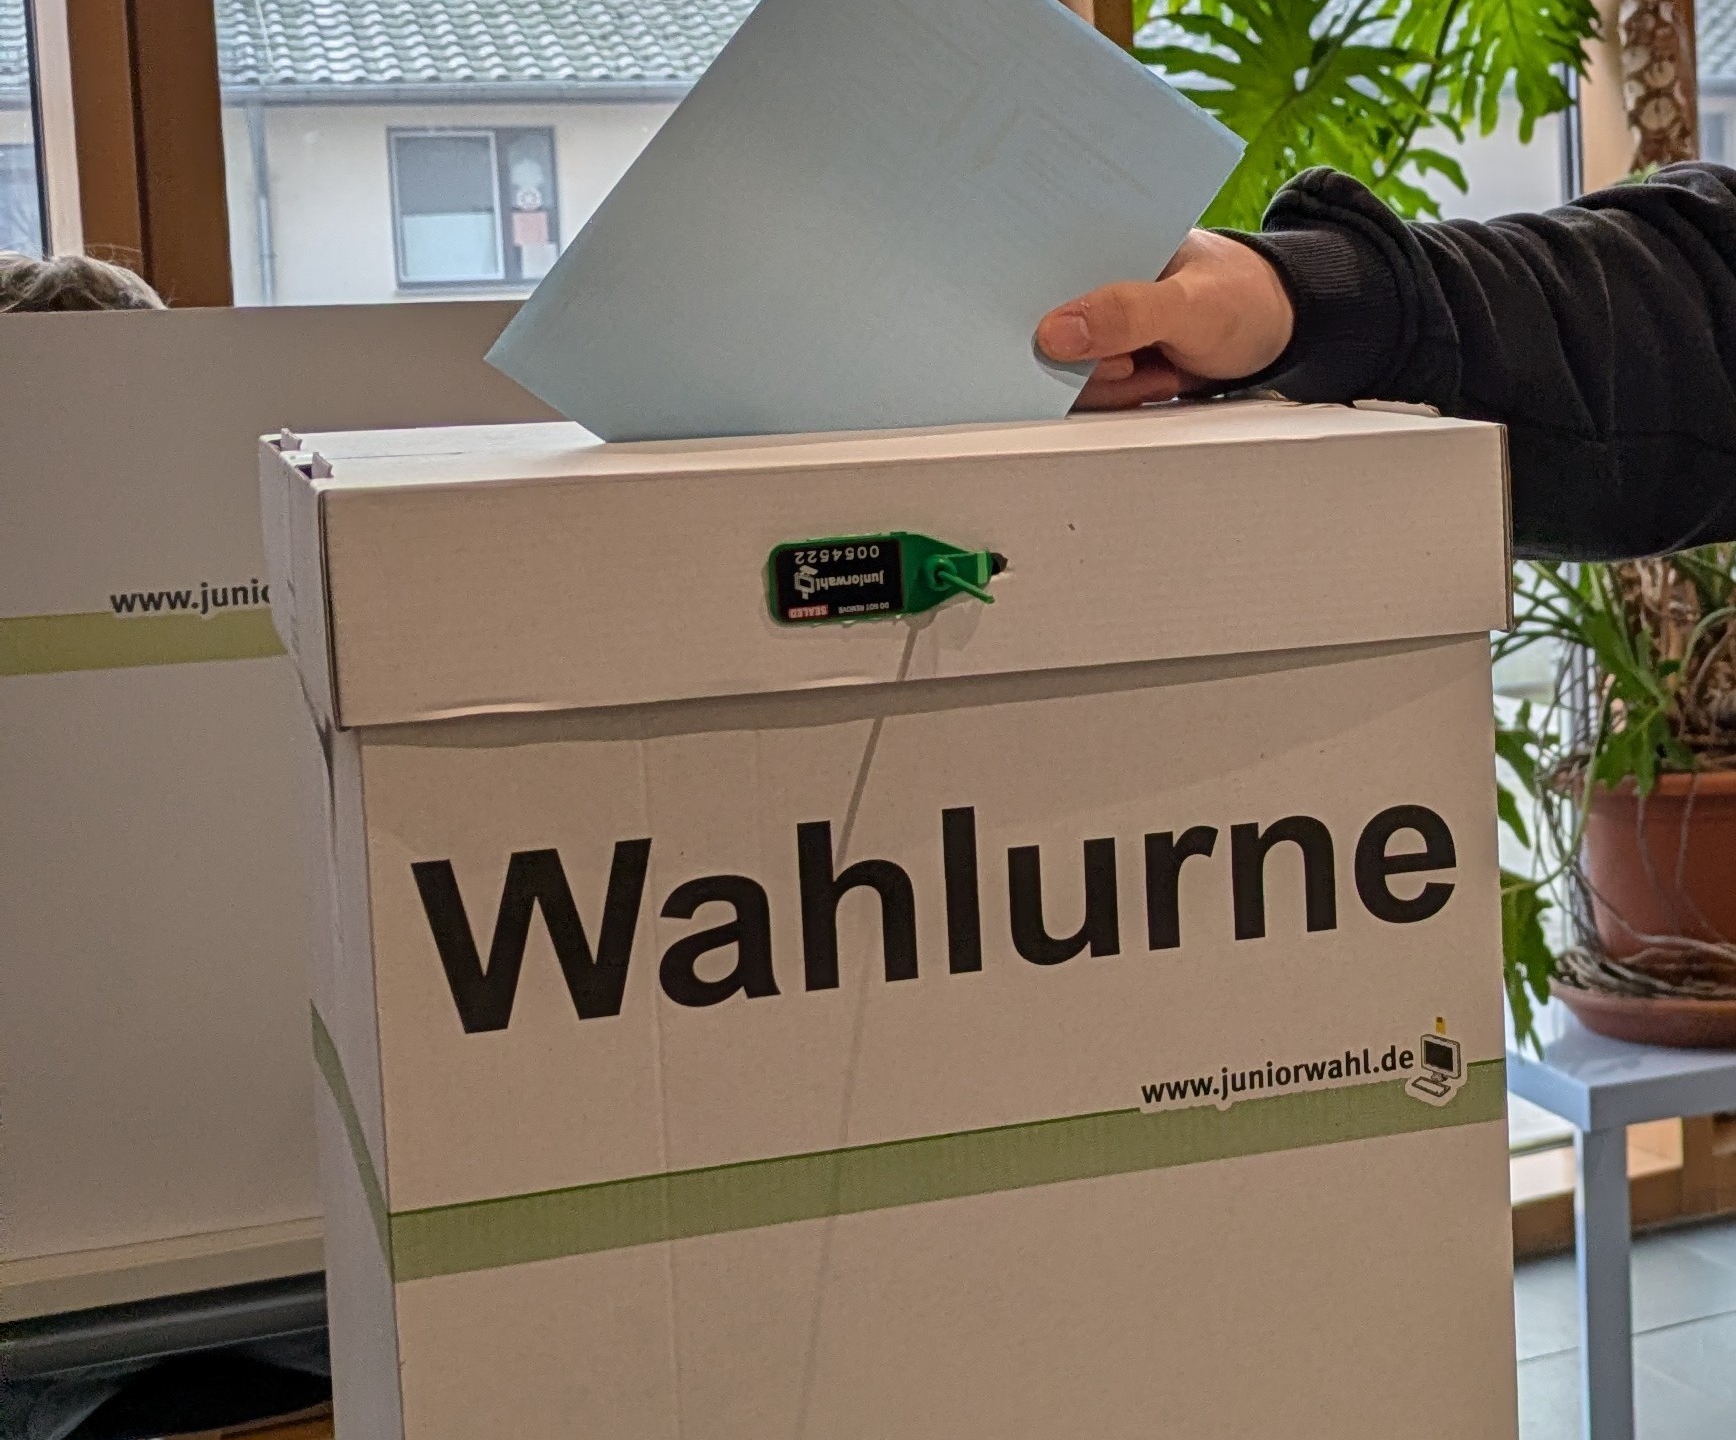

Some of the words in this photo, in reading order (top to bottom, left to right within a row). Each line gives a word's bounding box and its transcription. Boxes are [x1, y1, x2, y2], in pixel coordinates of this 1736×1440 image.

[794, 545, 880, 564] 0054522
[788, 605, 828, 618] SEALED
[411, 803, 1457, 1035] Wahlurne
[1141, 1045, 1415, 1104] www.juniorwahl.de
